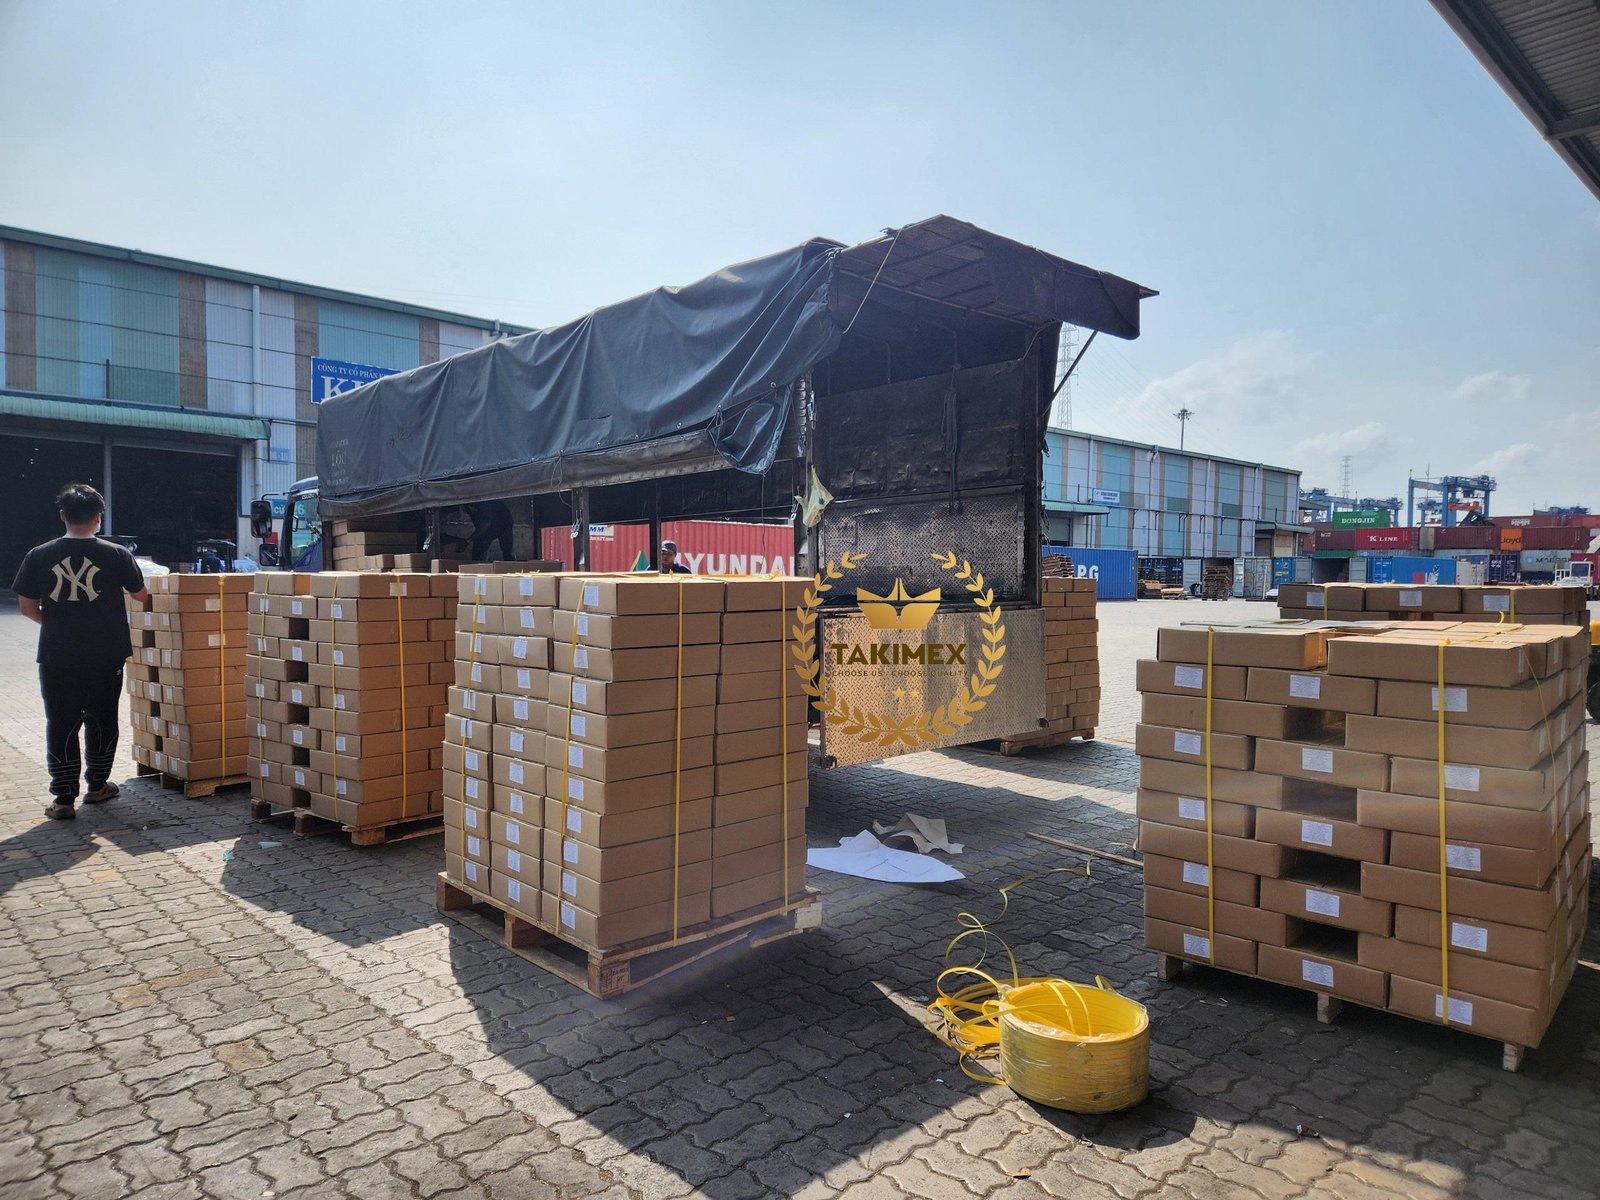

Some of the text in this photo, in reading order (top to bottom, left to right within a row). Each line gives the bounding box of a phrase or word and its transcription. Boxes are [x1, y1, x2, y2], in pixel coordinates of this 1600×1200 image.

[339, 367, 347, 375] TY
[674, 552, 795, 577] YUNDAI
[50, 556, 101, 602] NY
